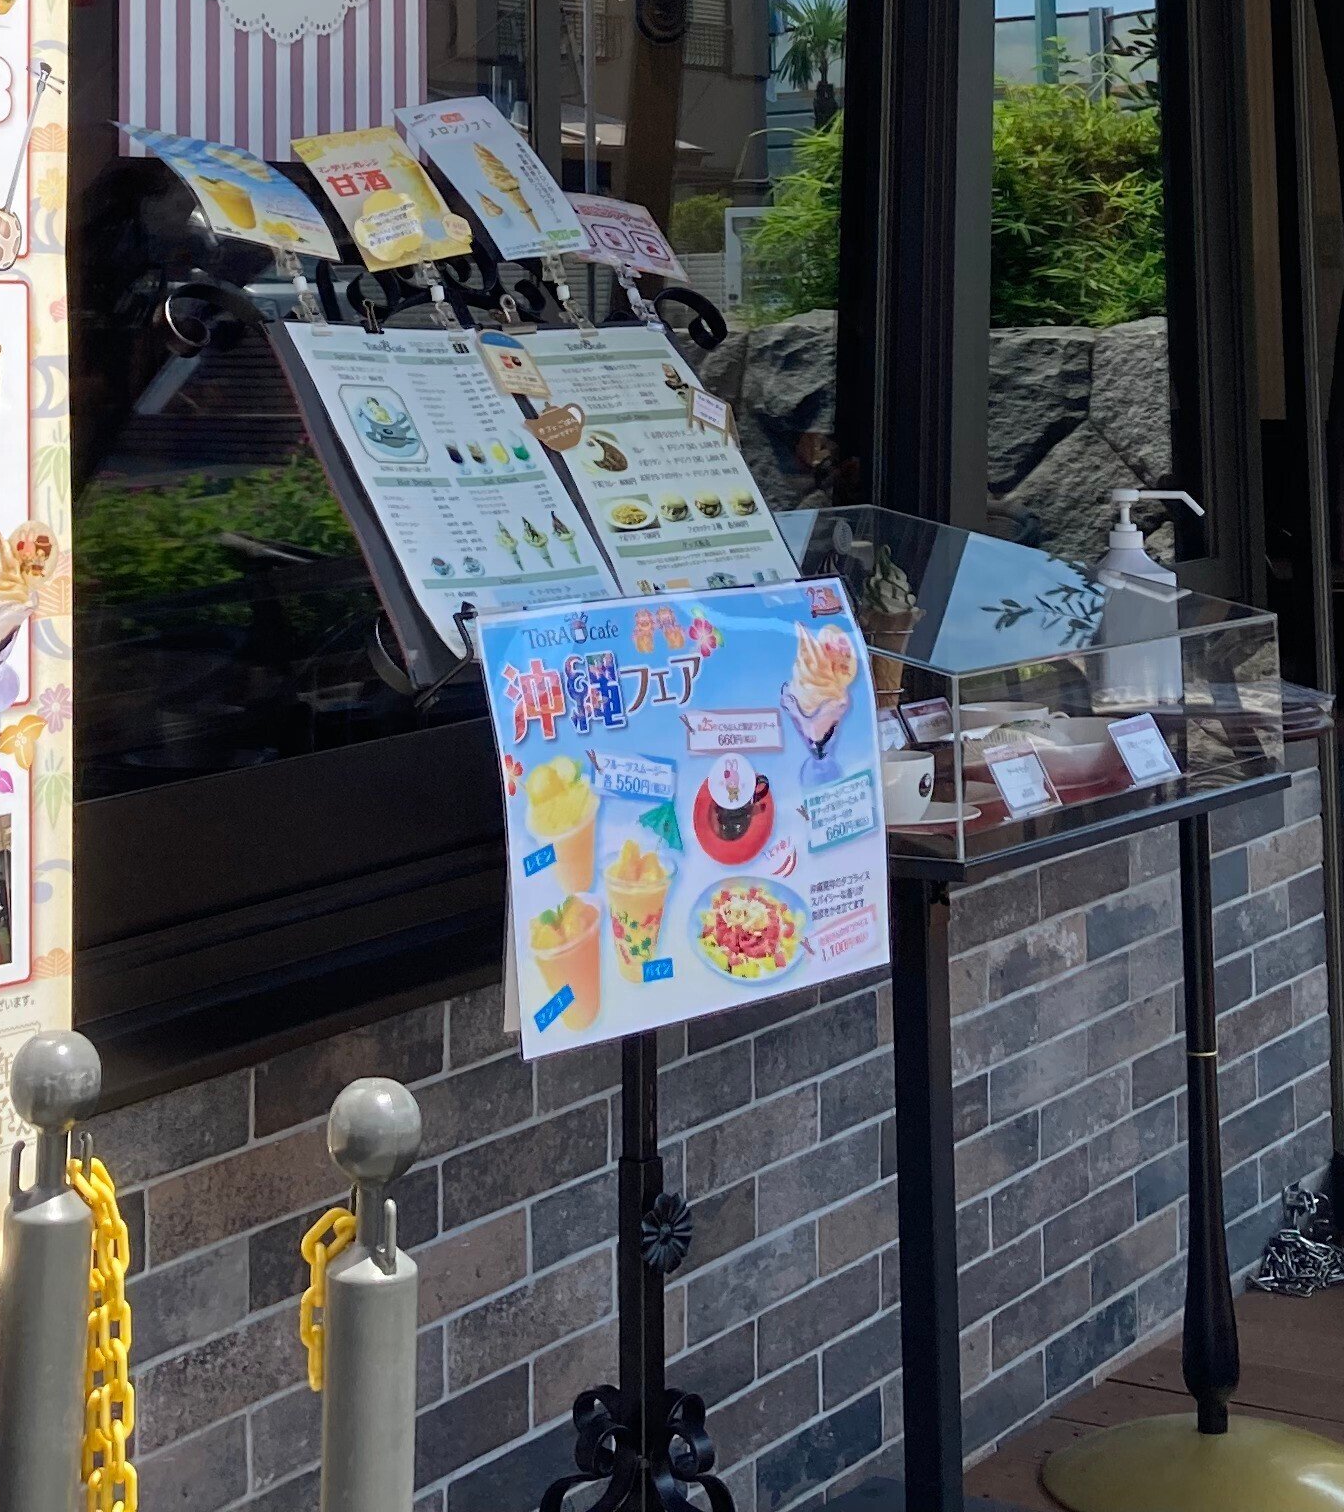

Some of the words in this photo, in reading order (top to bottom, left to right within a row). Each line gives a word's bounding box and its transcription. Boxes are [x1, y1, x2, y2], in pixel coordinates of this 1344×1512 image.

[428, 118, 493, 138] メロンソフト
[326, 169, 394, 198] 甘酒
[503, 650, 703, 746] 沖縄フェア
